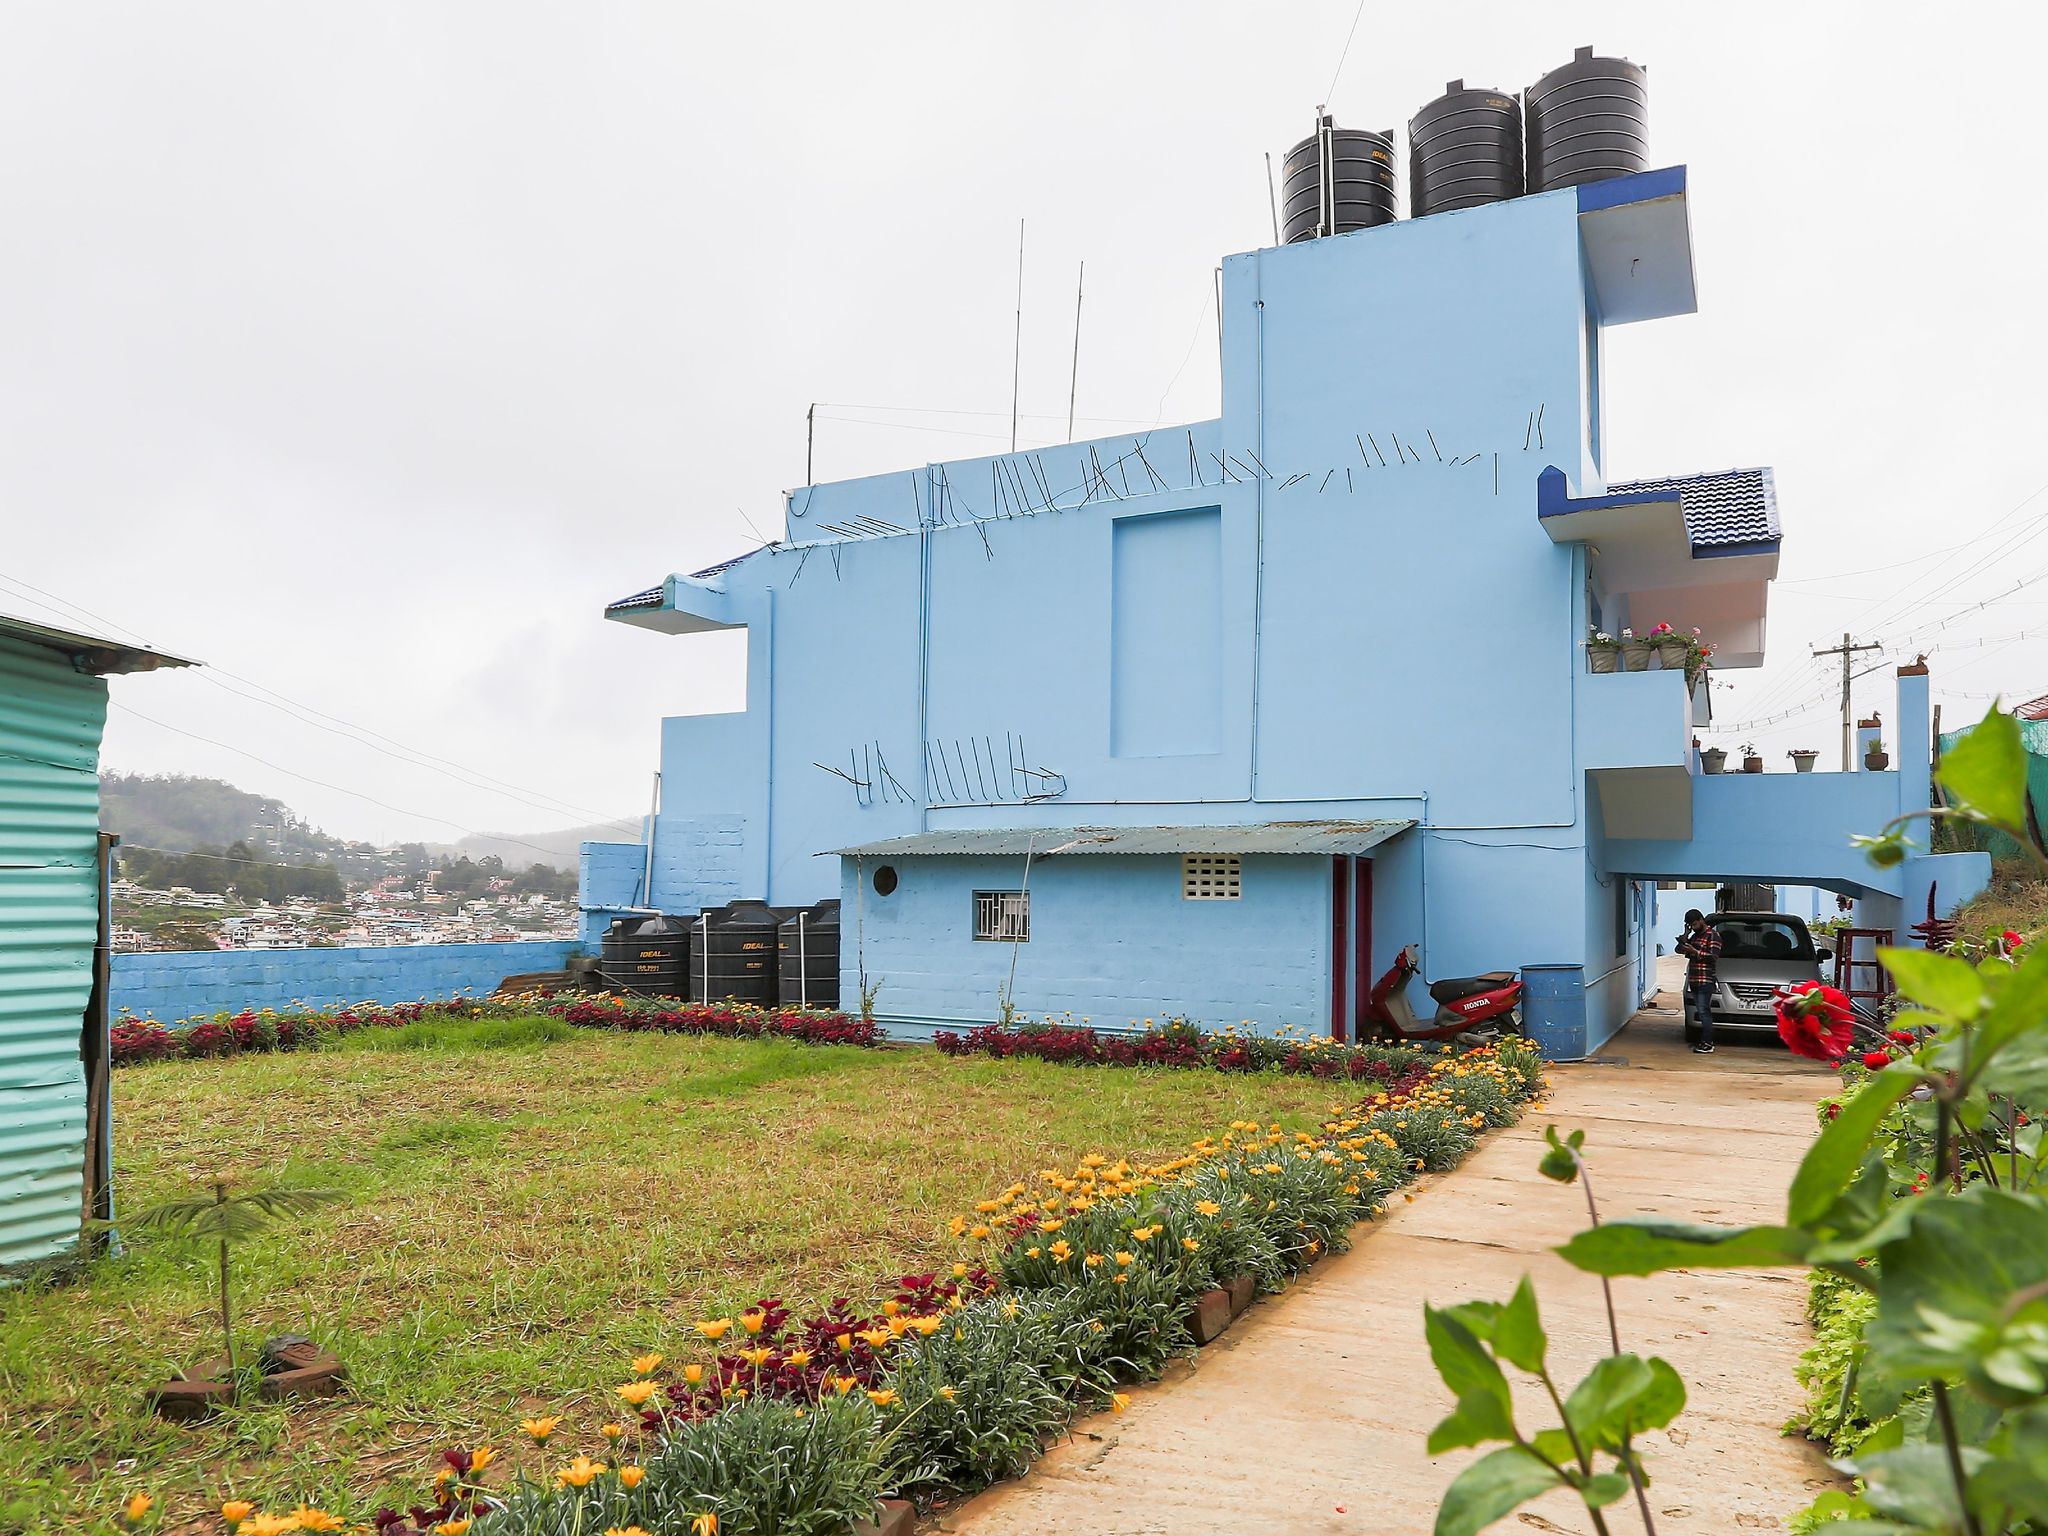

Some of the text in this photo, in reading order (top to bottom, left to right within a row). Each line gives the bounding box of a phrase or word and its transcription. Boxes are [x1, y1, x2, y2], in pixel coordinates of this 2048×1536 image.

[743, 942, 764, 950] IDEAL
[640, 951, 662, 959] IDEAL
[1463, 998, 1490, 1010] HONDA
